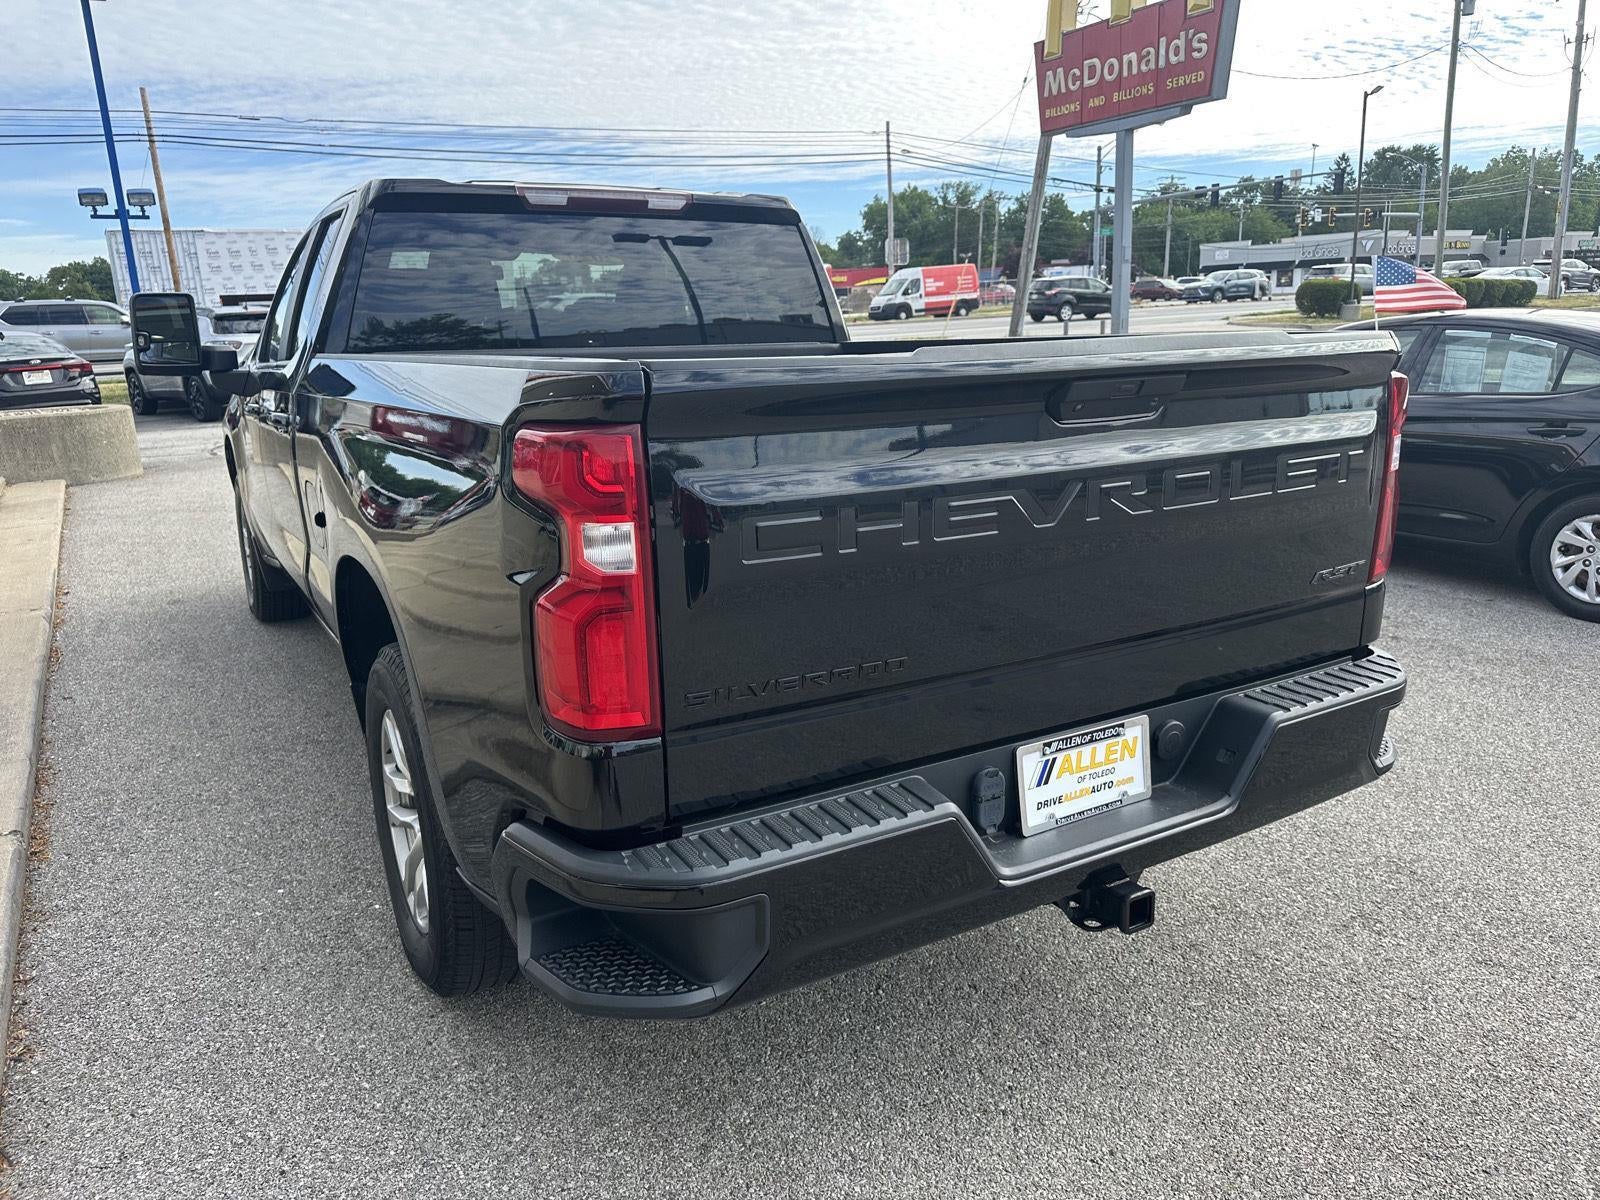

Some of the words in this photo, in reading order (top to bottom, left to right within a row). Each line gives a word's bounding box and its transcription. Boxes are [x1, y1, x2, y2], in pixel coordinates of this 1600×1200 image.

[1043, 28, 1208, 98] McDonald's
[1045, 101, 1081, 118] BILLIONS
[1088, 95, 1105, 108] AND
[1113, 83, 1154, 102] BILLIONS
[1166, 71, 1205, 89] SERVED
[740, 446, 1365, 565] CHEVROLET
[1309, 559, 1367, 585] RST
[685, 657, 908, 711] SILVERADO
[1056, 736, 1138, 780] ALLEN
[1057, 736, 1082, 750] ALLEN
[1082, 734, 1093, 743] OF
[1093, 727, 1119, 741] TOLEDO
[1036, 776, 1135, 811] DRIVEALLENAUTO.com
[1077, 774, 1088, 784] OF
[1088, 766, 1116, 781] TOLEDO
